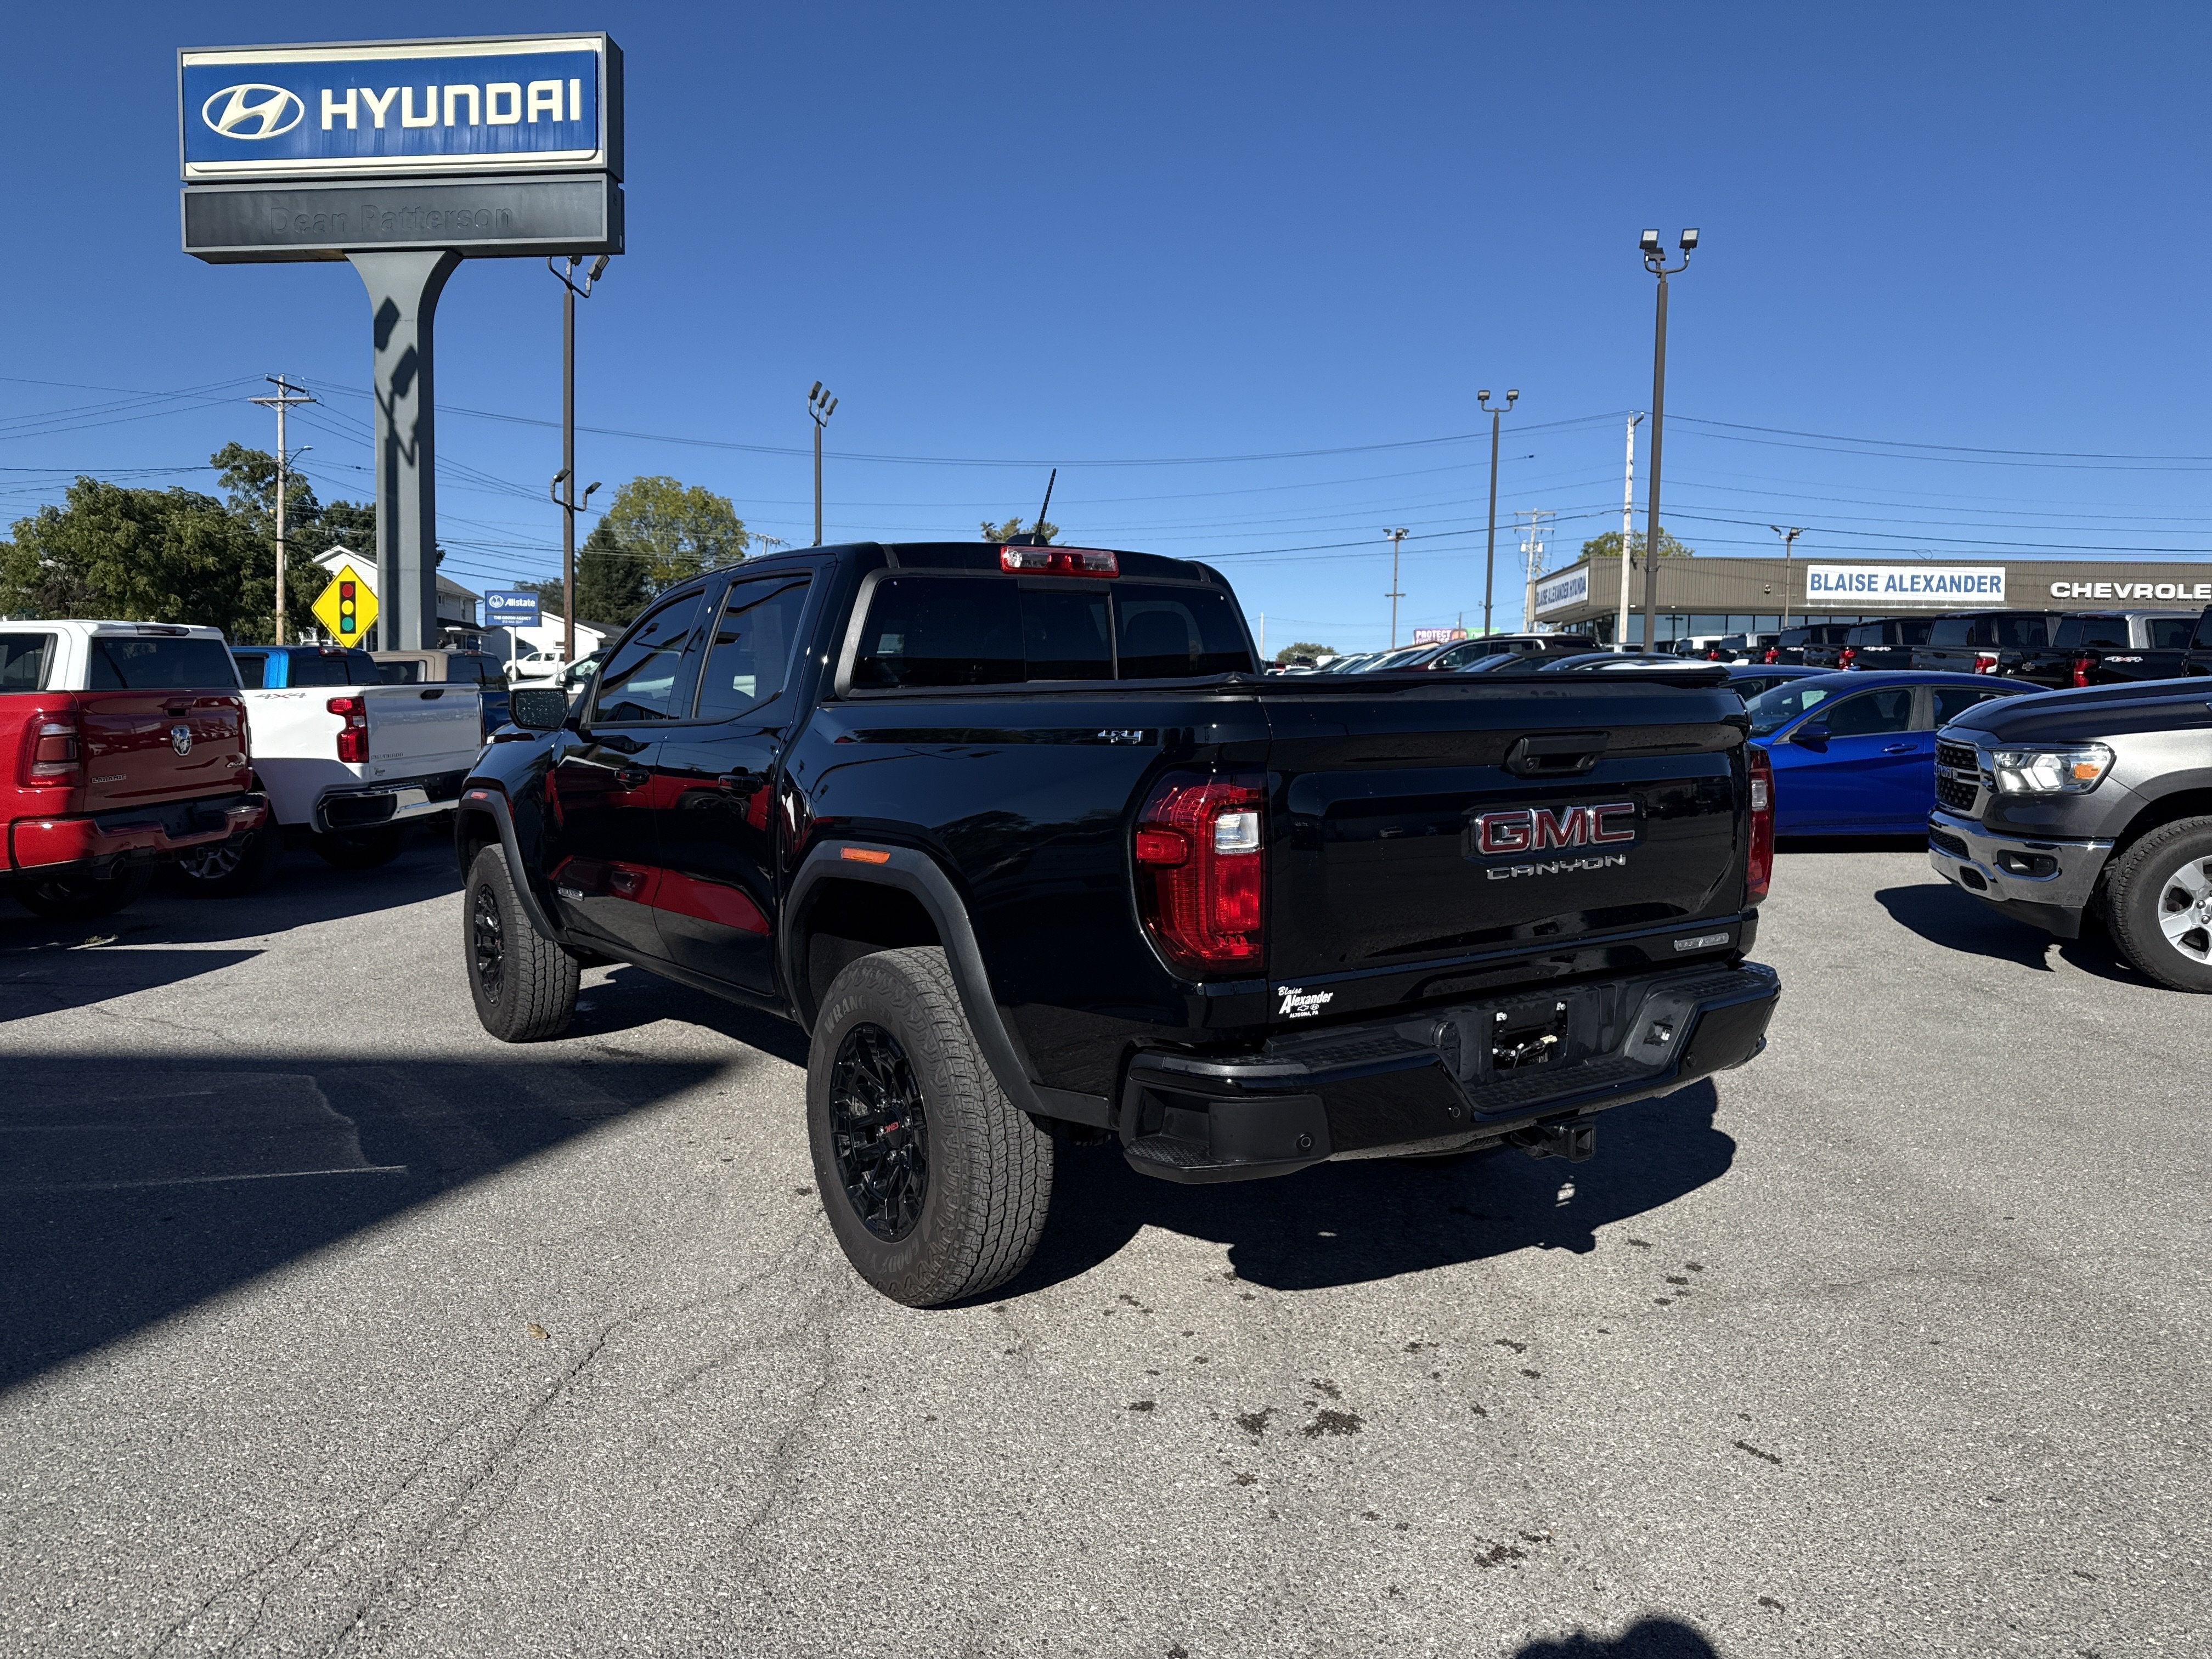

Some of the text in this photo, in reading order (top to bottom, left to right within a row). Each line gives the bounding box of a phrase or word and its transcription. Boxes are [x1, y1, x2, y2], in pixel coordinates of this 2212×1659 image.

[321, 78, 582, 129] HYUNDAI
[270, 205, 514, 234] Dean Patterson
[1810, 573, 2002, 593] BLAISE ALEXANDER
[2051, 582, 2211, 600] CHEVROLE
[505, 599, 535, 607] Allstate
[1416, 630, 1452, 639] PROTECT
[93, 774, 126, 783] LARAMIE
[1475, 802, 1635, 854] GMC
[1486, 854, 1627, 881] CANYON
[1278, 986, 1302, 996] Blaise
[1278, 991, 1334, 1014] Alexander
